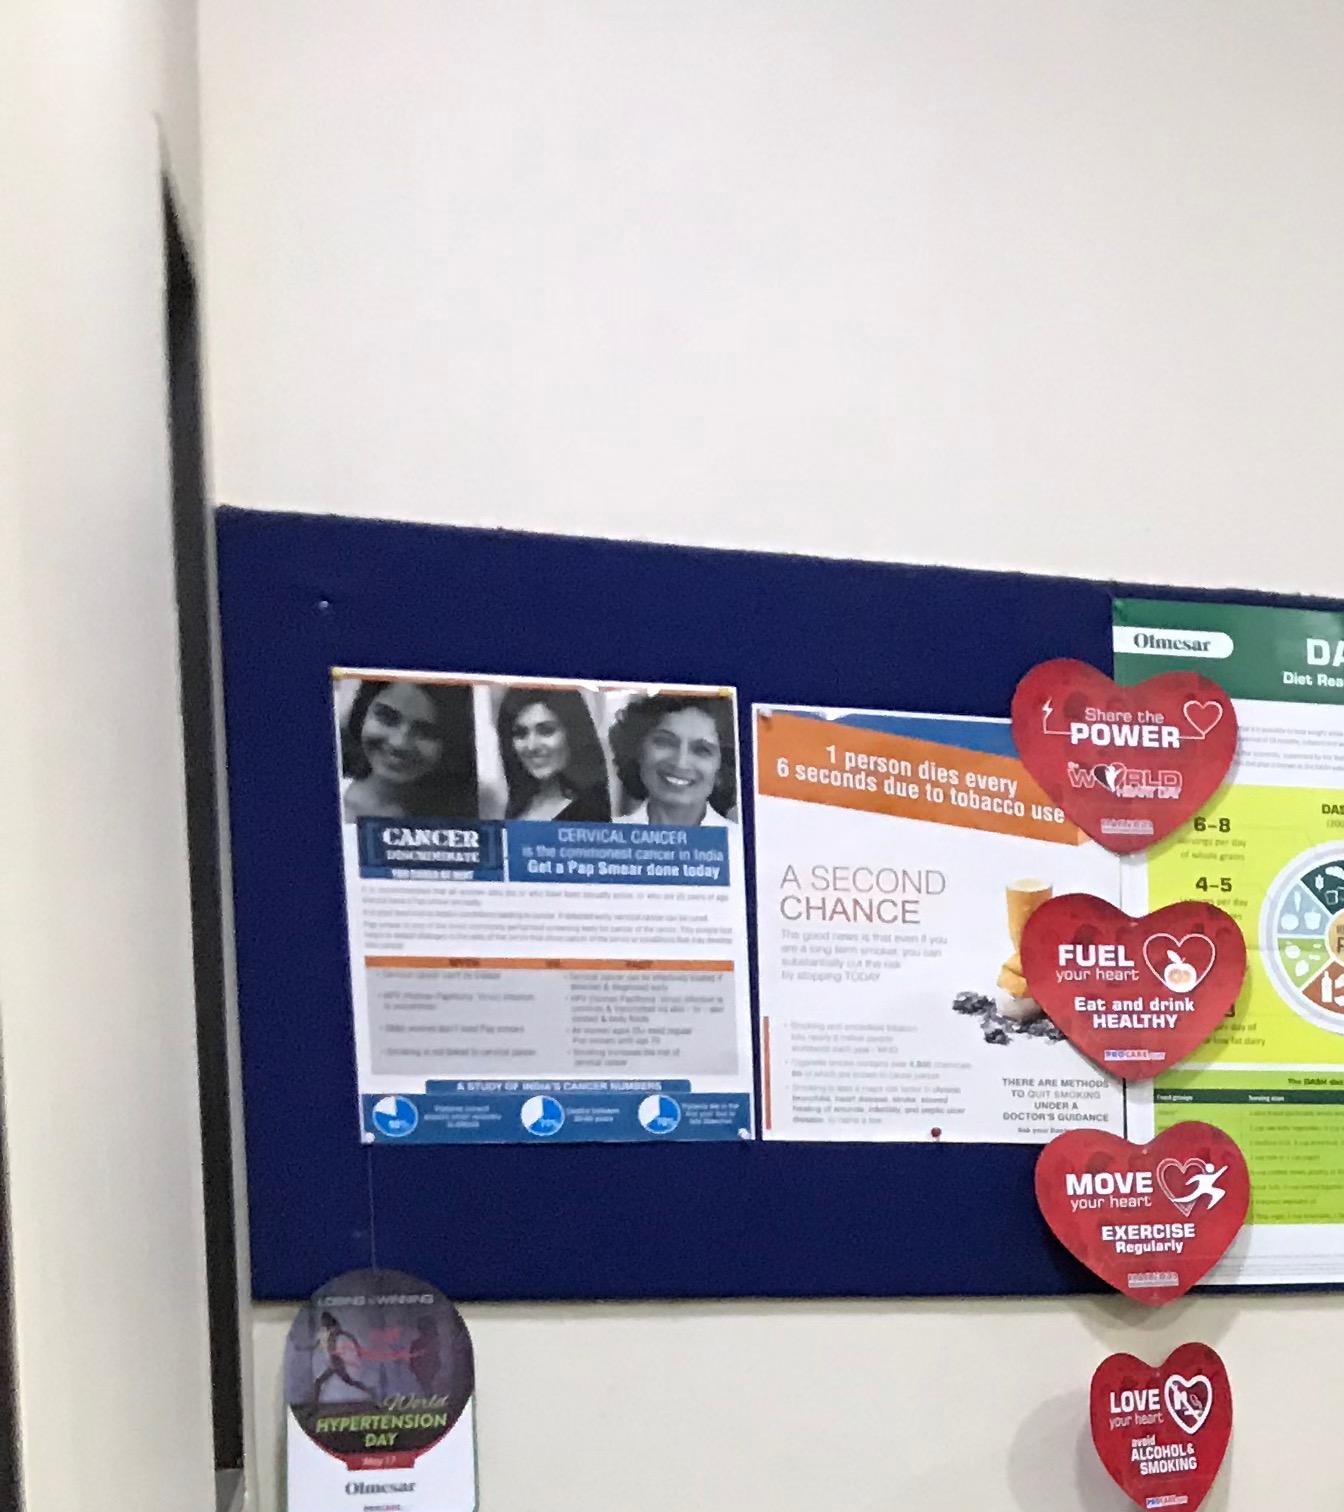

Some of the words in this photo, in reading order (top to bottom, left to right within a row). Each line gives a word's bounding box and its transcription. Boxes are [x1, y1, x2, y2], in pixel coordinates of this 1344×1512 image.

[1133, 632, 1211, 652] Olmesar
[1283, 671, 1312, 686] Diet
[1085, 707, 1132, 723] Share
[1137, 710, 1164, 724] the
[1070, 722, 1180, 748] POWER
[826, 745, 836, 764] 1
[845, 750, 912, 778] person
[919, 760, 960, 785] dies
[966, 771, 1018, 799] every
[777, 757, 789, 778] 6
[795, 763, 878, 792] seconds
[884, 775, 920, 800] due
[926, 783, 944, 804] to
[950, 786, 1025, 817] tobacco
[1031, 805, 1065, 824] use
[383, 828, 480, 847] CANCER
[558, 828, 626, 843] CERVICAL
[631, 831, 688, 845] CANCER
[695, 849, 723, 861] India
[527, 859, 552, 873] Get
[568, 860, 593, 877] Pap
[598, 861, 641, 875] Smear
[647, 863, 679, 876] done
[683, 863, 720, 879] today
[780, 864, 801, 890] A
[811, 866, 947, 896] SECOND
[779, 895, 921, 925] CHANCE
[1058, 944, 1135, 967] FUEL
[1056, 969, 1091, 983] your
[1096, 968, 1140, 981] heart
[1074, 997, 1106, 1012] Eat
[1112, 997, 1144, 1012] and
[1149, 997, 1195, 1012] drink
[1093, 1014, 1178, 1029] HEALTHY
[1002, 1078, 1035, 1087] THERE
[1038, 1079, 1057, 1087] ARE
[1060, 1079, 1109, 1088] METHODS
[1012, 1090, 1025, 1098] TO
[1027, 1090, 1051, 1099] QUIT
[1054, 1091, 1101, 1099] SMOKING
[1034, 1102, 1069, 1110] UNDER
[1003, 1112, 1055, 1121] DOCTOR'S
[1057, 1113, 1109, 1122] GUIDANCE
[1065, 1172, 1153, 1196] MOVE
[1070, 1197, 1105, 1212] your
[1109, 1196, 1152, 1207] heart
[1101, 1223, 1195, 1241] EXERCISE
[1115, 1240, 1184, 1254] Regularly
[1110, 1389, 1160, 1413] LOVE
[316, 1413, 447, 1433] HYPERTENSION
[1109, 1415, 1132, 1431] your
[1134, 1412, 1165, 1425] heart
[365, 1432, 398, 1447] DAY
[1131, 1434, 1155, 1447] avoid
[1140, 1457, 1197, 1475] SMOKING
[345, 1481, 416, 1495] Olmesar
